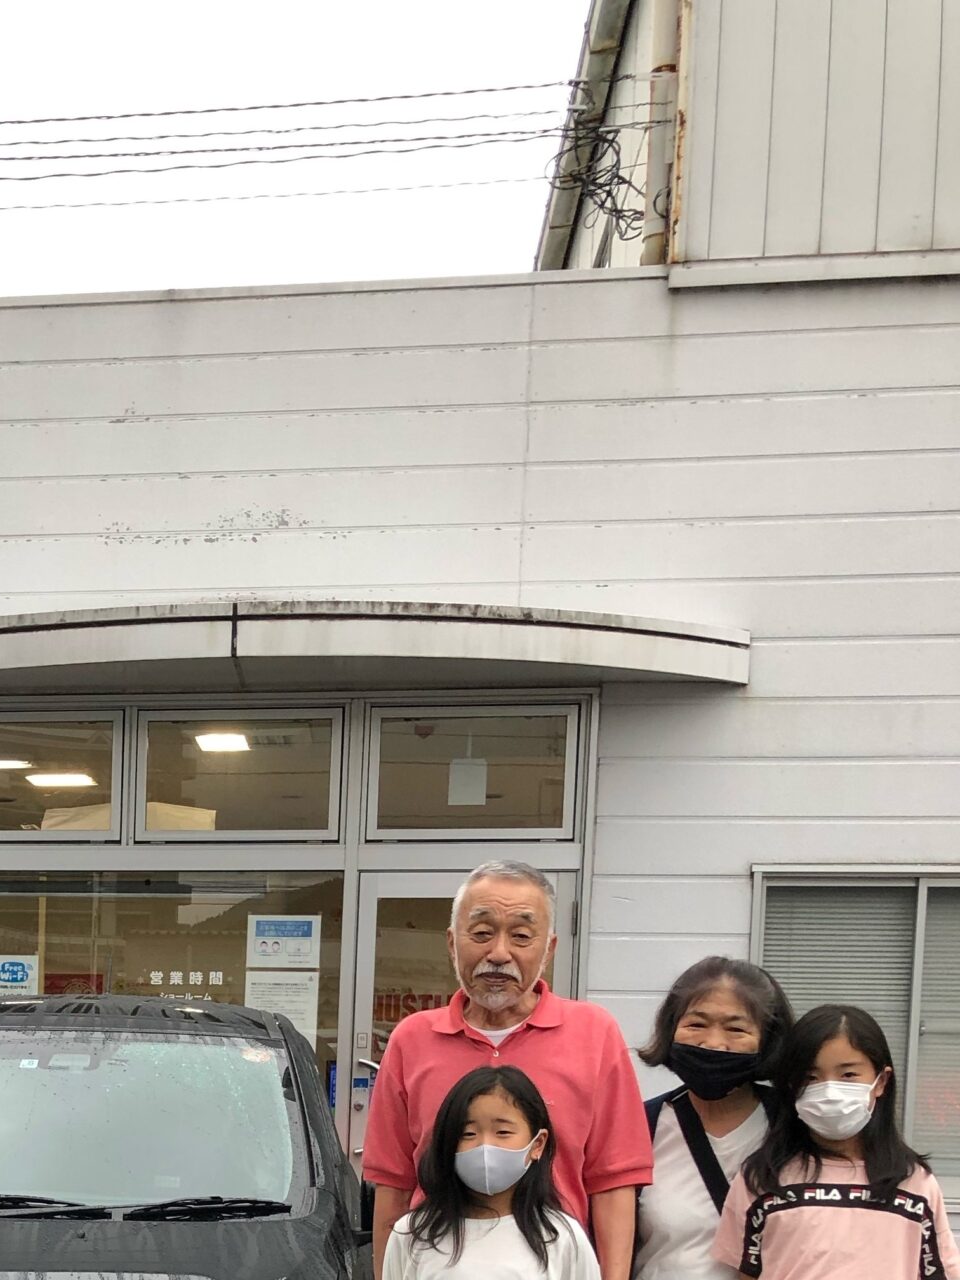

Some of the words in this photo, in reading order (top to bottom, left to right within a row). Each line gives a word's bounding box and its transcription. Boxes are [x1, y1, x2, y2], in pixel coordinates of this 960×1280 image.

[4, 963, 23, 971] Free
[0, 971, 27, 981] Wi-Fi
[149, 970, 223, 985] 営業時間
[159, 992, 212, 1001] ショールーム
[803, 1188, 843, 1201] FILA
[894, 1194, 925, 1215] FILA
[747, 1233, 762, 1265] FILA
[922, 1243, 937, 1276] FILA
